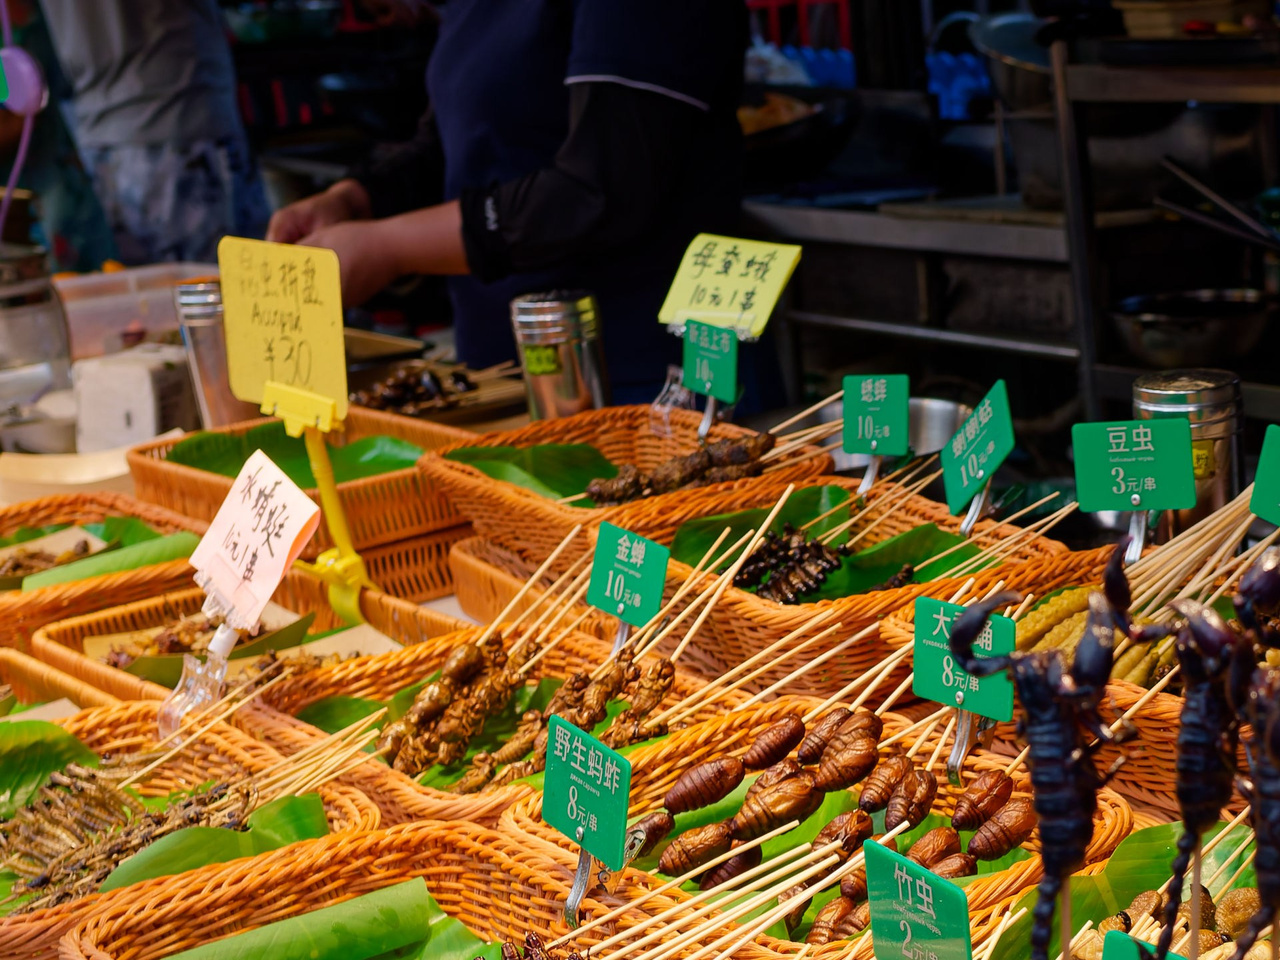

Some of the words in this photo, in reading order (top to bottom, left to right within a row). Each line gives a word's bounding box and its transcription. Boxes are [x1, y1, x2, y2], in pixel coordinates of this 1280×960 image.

[1107, 424, 1155, 453] 豆虫
[1110, 466, 1157, 495] 3元/串
[615, 534, 647, 569] 金蝉
[604, 570, 642, 608] 10元/串
[932, 606, 993, 651] 大蛹
[942, 655, 979, 692] 8元/串
[554, 724, 621, 795] 野生蚂蚱
[567, 785, 598, 832] 8元/串
[893, 862, 936, 920] 竹虫
